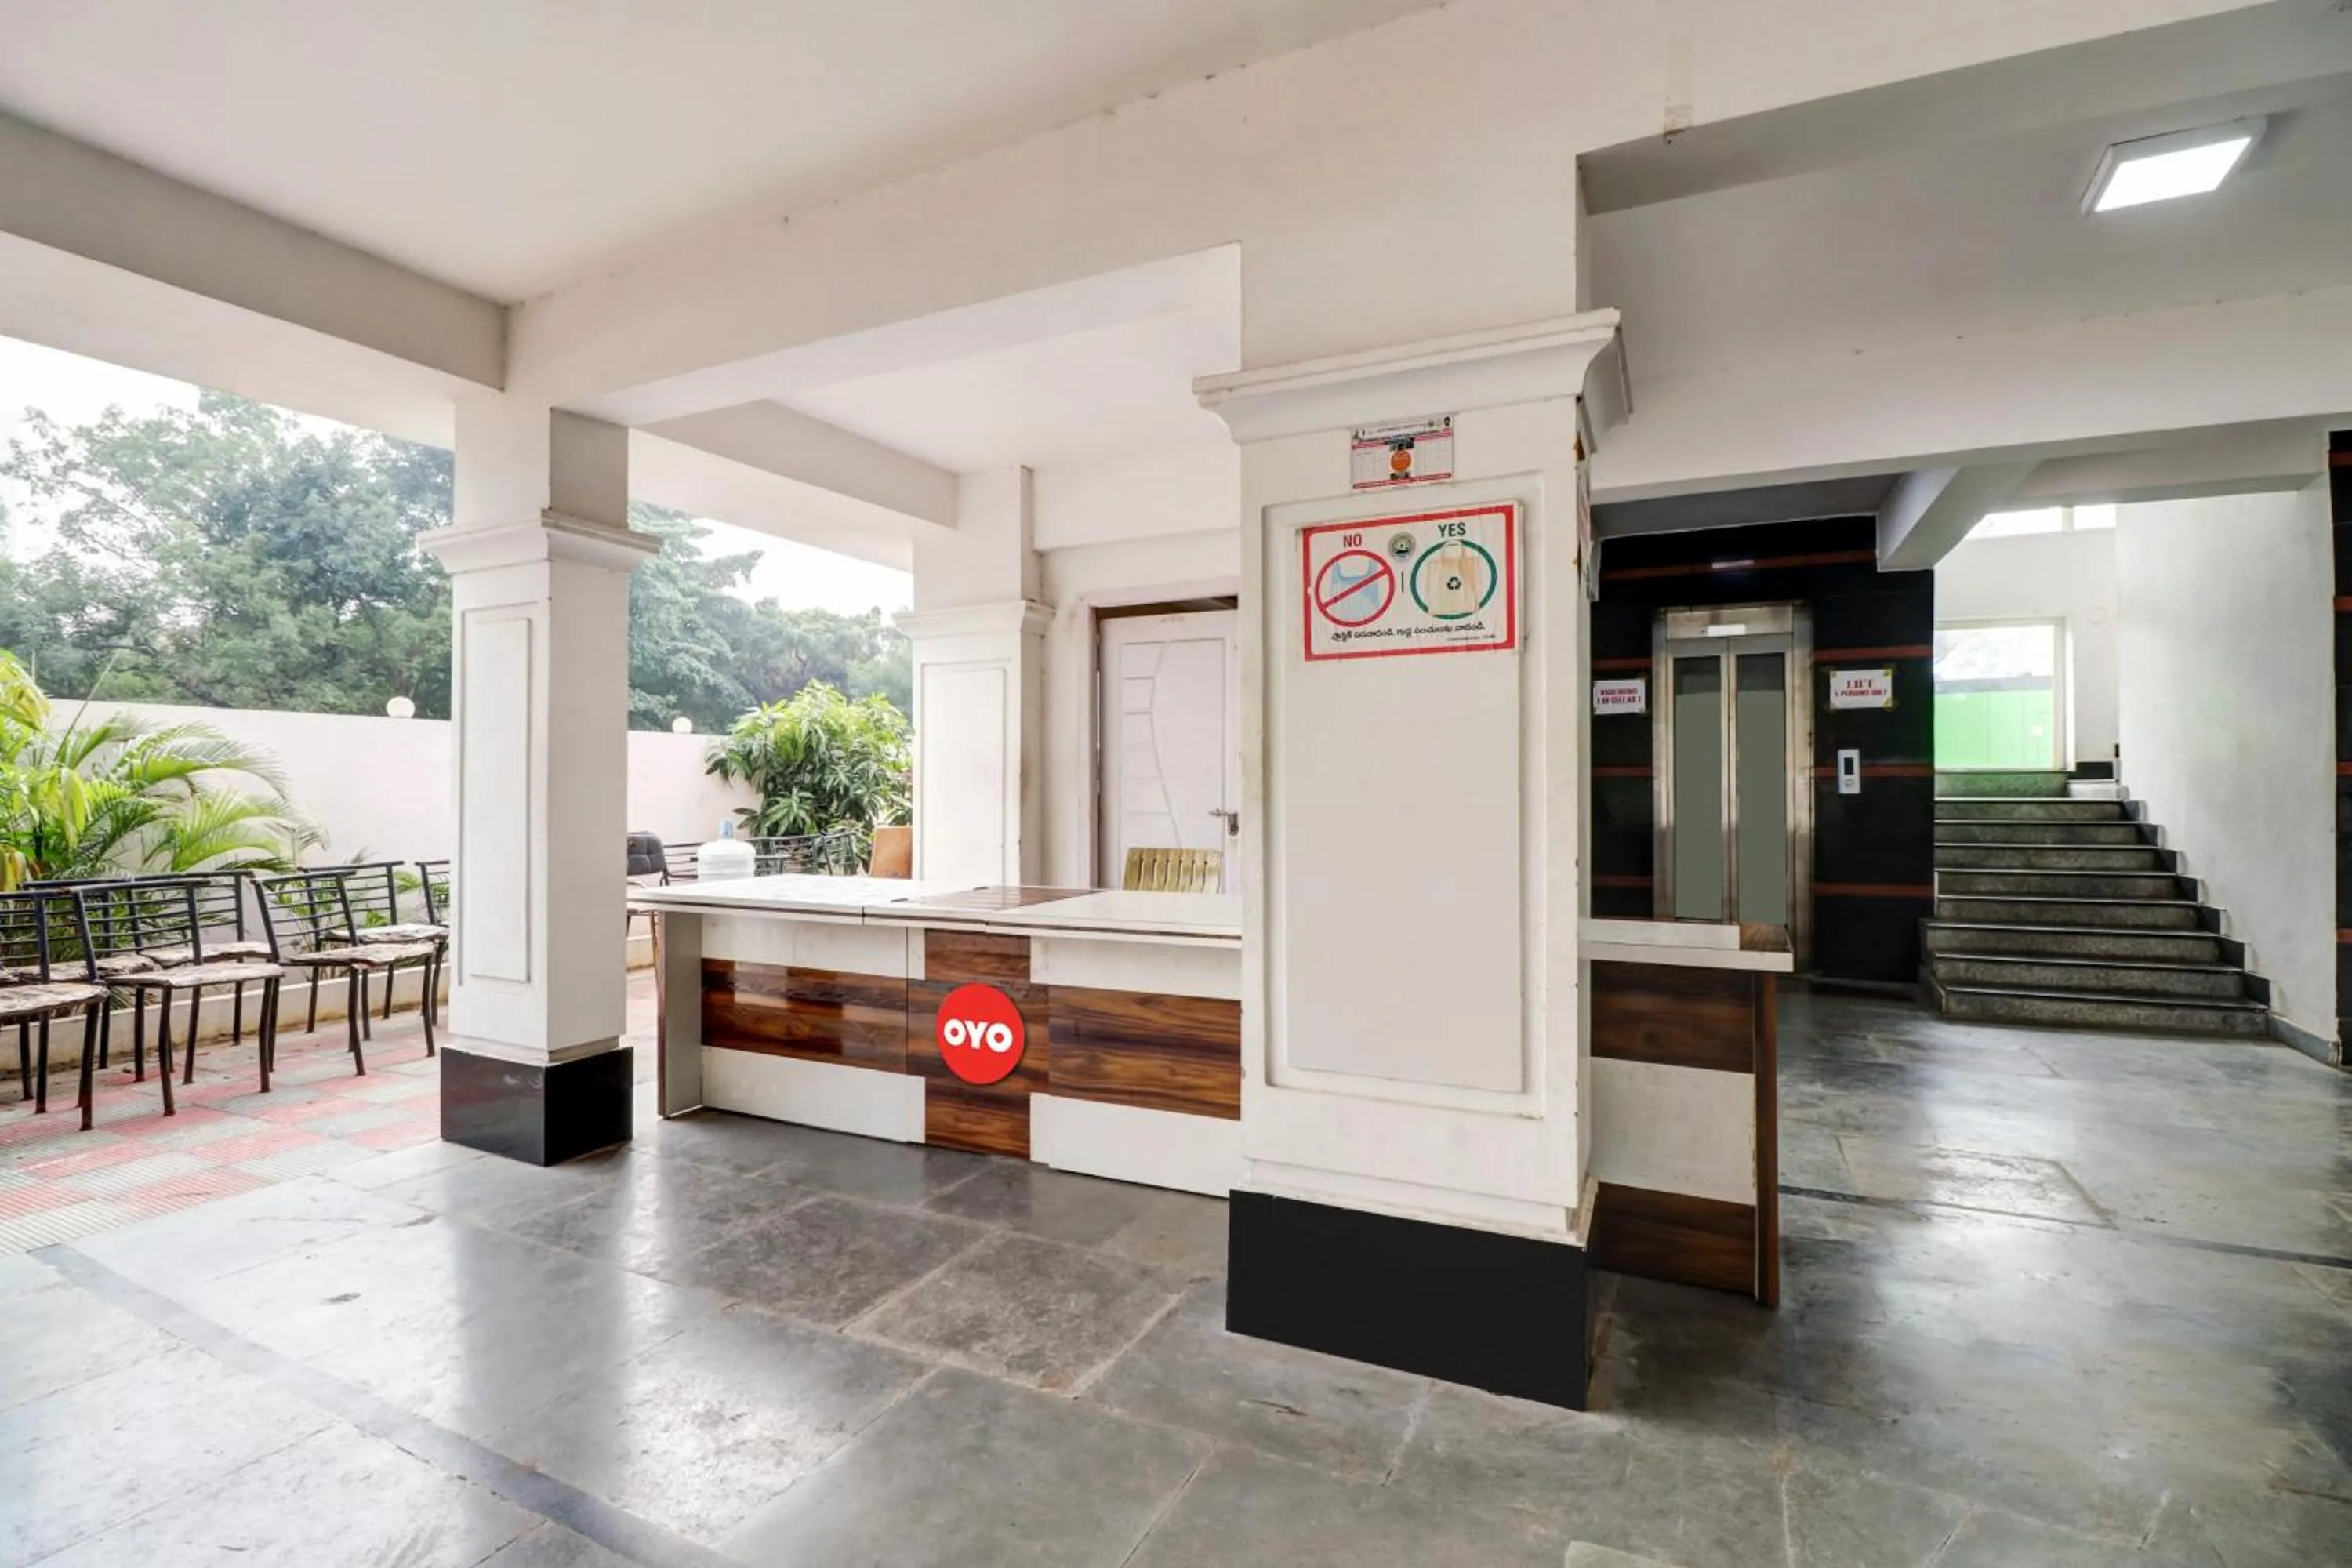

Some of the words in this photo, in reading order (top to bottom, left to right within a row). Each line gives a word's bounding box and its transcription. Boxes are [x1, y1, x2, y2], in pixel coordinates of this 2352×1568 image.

[1438, 521, 1466, 538] YES
[1342, 533, 1362, 548] NO
[943, 1018, 1014, 1053] OYO
